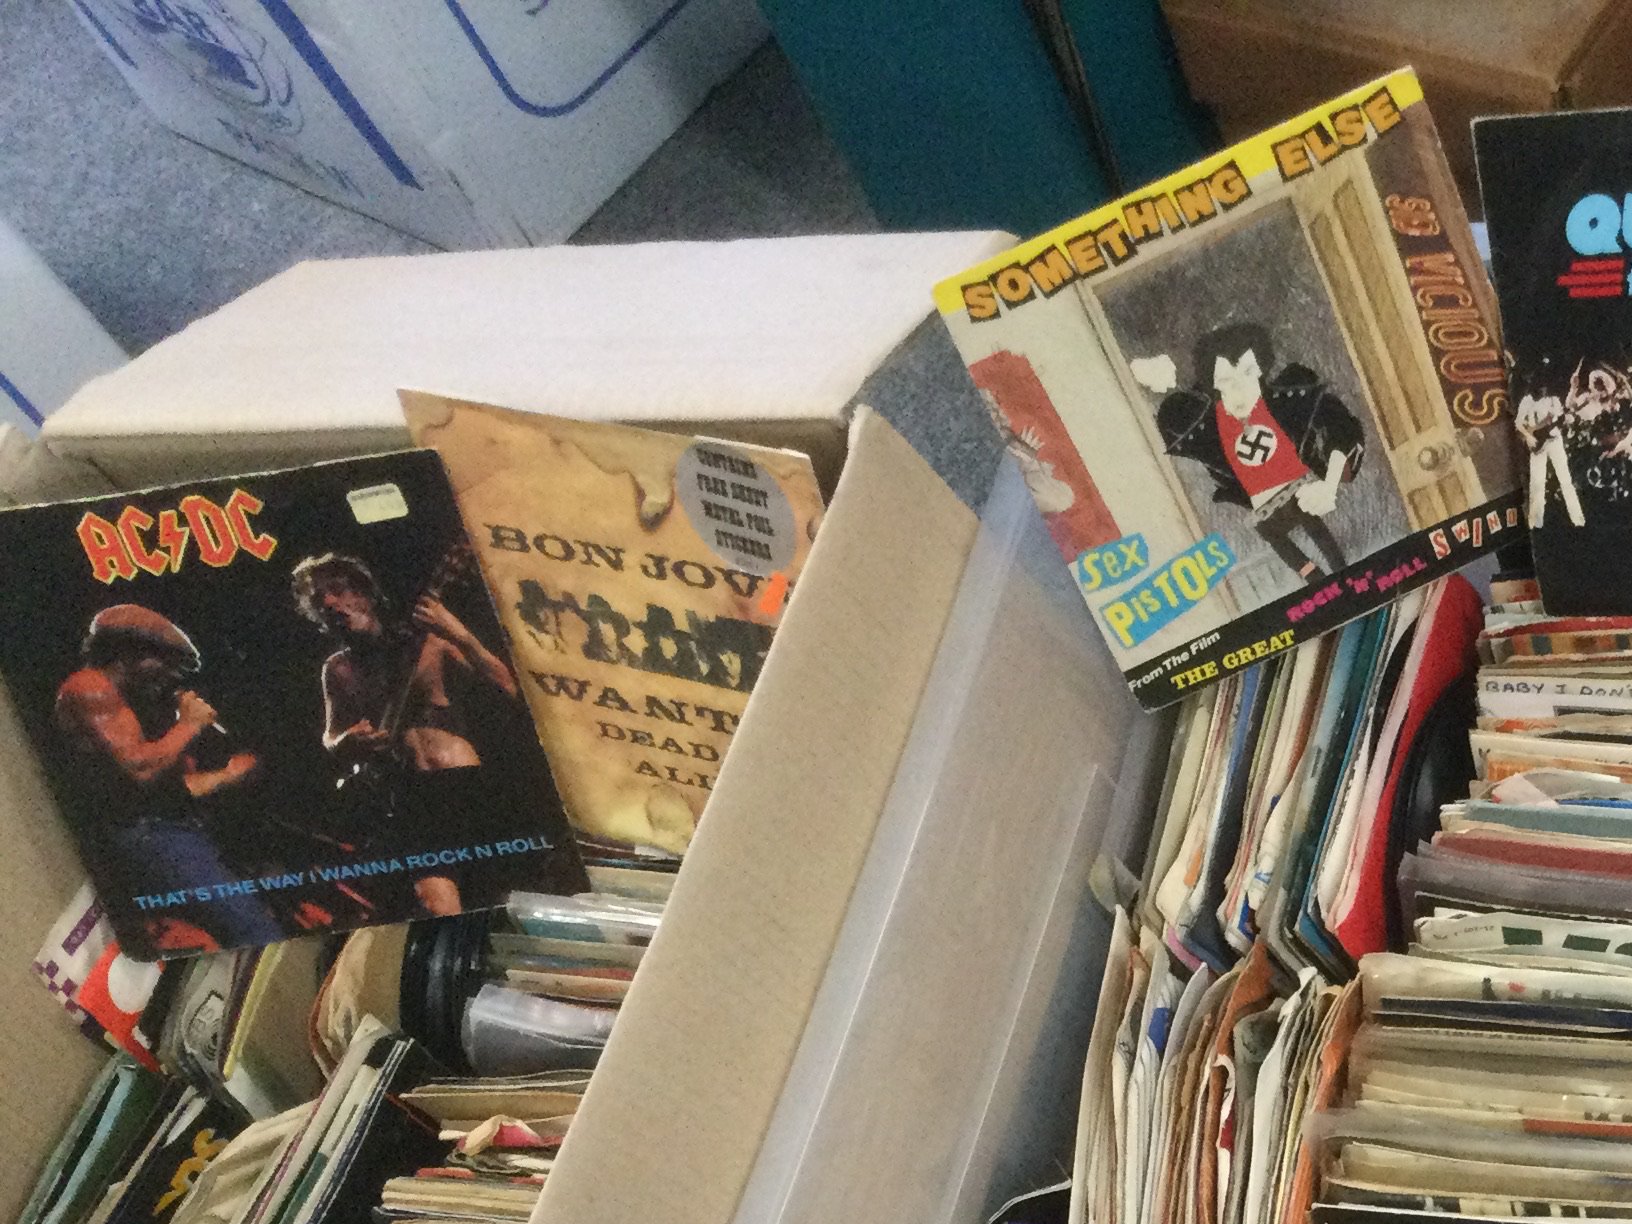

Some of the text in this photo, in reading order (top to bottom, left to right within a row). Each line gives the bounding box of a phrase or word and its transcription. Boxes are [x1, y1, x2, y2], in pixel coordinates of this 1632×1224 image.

[961, 87, 1401, 322] SOMETHING ELSE
[482, 521, 793, 604] BON JOV
[1128, 632, 1221, 691] From The Film
[1171, 629, 1296, 690] THE GREAT
[1485, 680, 1545, 695] BABY
[595, 719, 721, 764] DEAD
[133, 834, 555, 911] THAT'S THE WAY I WANNA ROCK N ROLL
